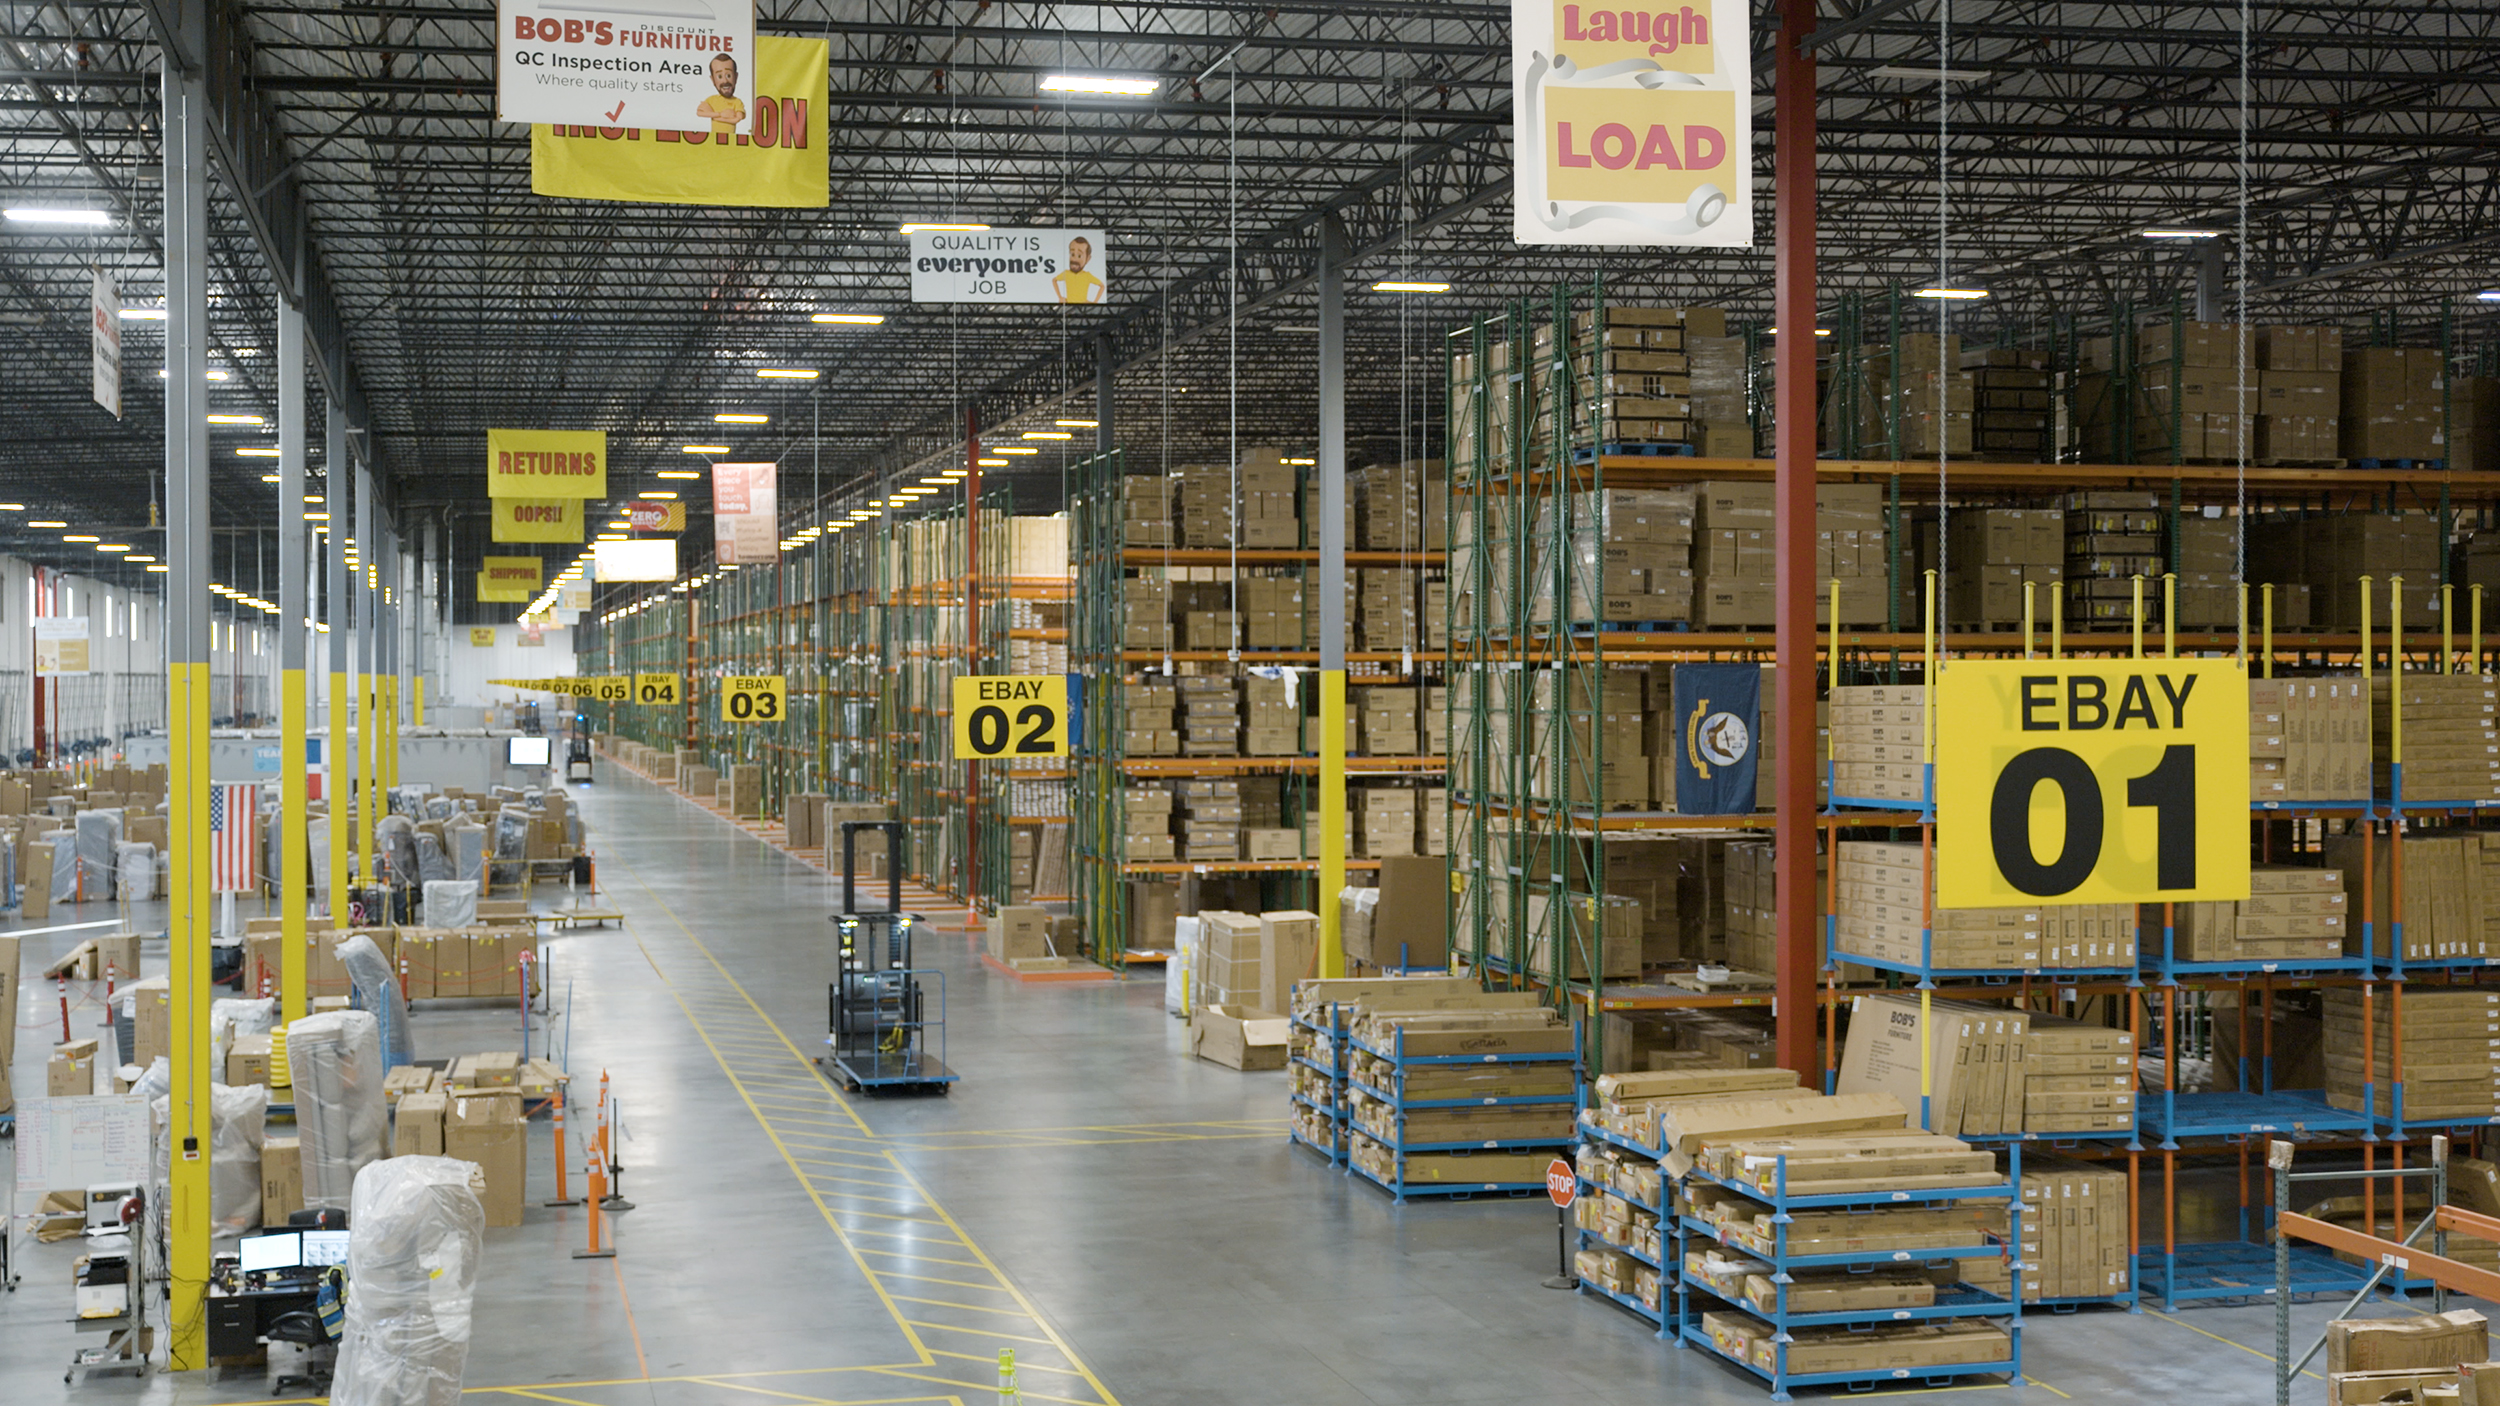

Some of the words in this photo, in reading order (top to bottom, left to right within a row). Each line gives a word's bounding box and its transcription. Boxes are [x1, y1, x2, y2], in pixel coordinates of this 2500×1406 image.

[515, 15, 614, 47] BOB'S
[619, 29, 734, 53] FURNITURE
[640, 24, 716, 35] DISCOUNT
[1562, 4, 1709, 57] Laugh
[515, 50, 545, 66] QC
[552, 53, 652, 73] Inspection
[658, 60, 703, 76] Area
[535, 73, 584, 88] Where
[588, 77, 638, 92] quality
[643, 80, 684, 93] starts
[1556, 121, 1727, 171] LOAD
[931, 235, 1017, 251] QUALITY
[1024, 236, 1041, 251] IS
[916, 255, 1057, 278] everyone's
[968, 280, 1007, 295] JOB
[498, 450, 597, 476] RETURNS
[513, 505, 563, 523] OOPS!!
[630, 510, 662, 522] ZERO
[489, 566, 537, 580] SHIPPING
[572, 683, 592, 696] 06
[645, 675, 671, 684] EBAY
[735, 678, 772, 690] EBAY
[600, 684, 626, 699] 05
[641, 684, 675, 703] 04
[979, 680, 1044, 700] EBAY
[729, 691, 778, 719] 03
[2019, 673, 2198, 732] EBAY
[967, 704, 1057, 756] 02
[1988, 743, 2197, 898] 01
[1890, 1010, 1916, 1027] BOB'S
[1548, 1172, 1573, 1194] STOP
